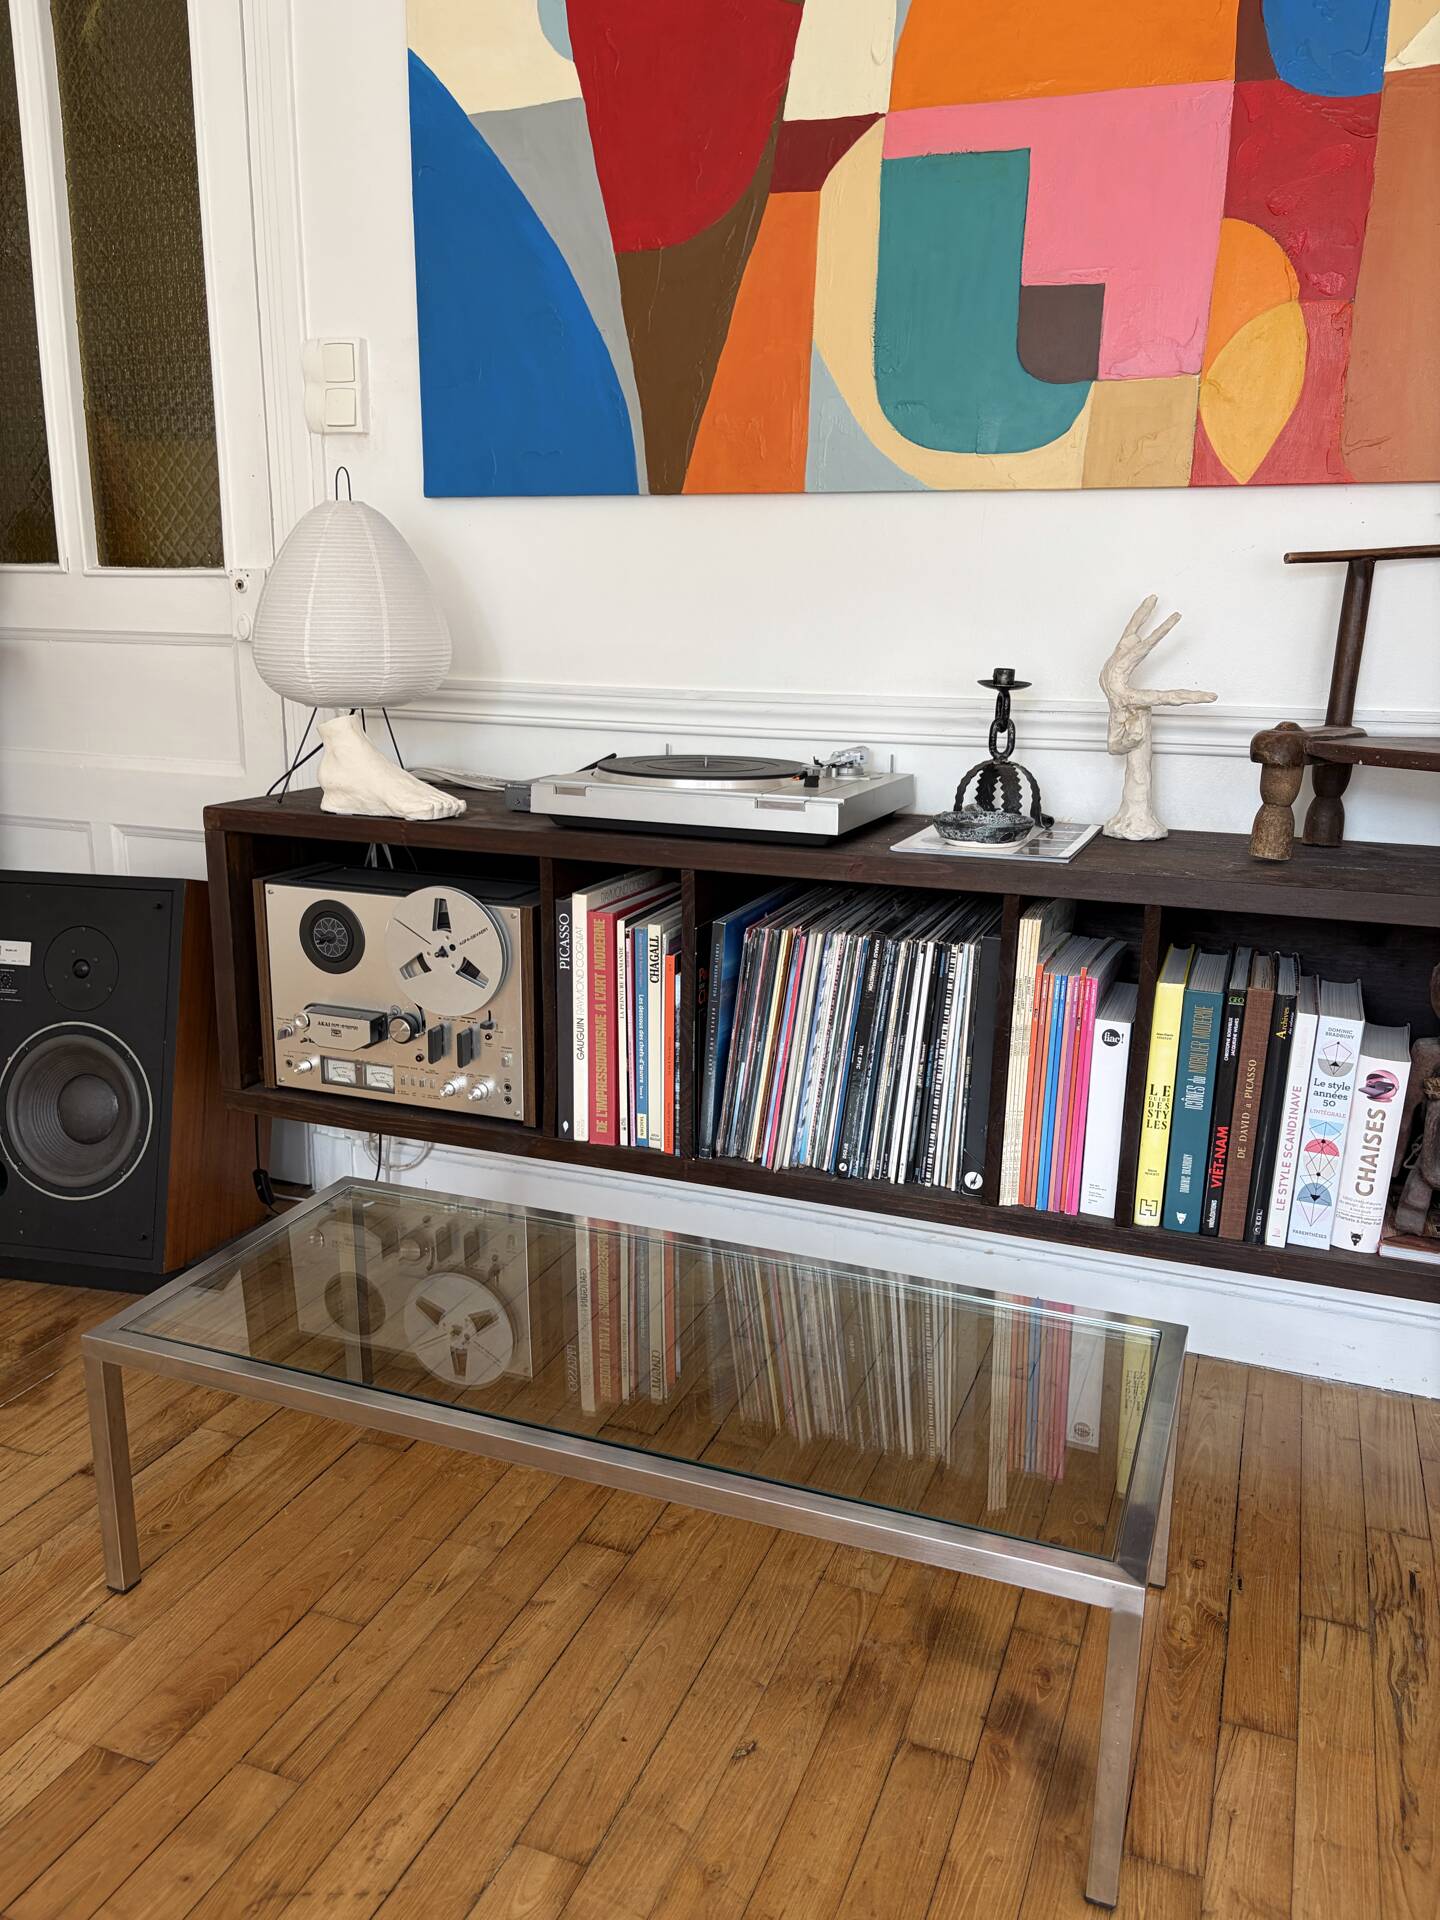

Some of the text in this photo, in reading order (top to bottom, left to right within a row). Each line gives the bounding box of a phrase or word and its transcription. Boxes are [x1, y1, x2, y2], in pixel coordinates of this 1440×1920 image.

[559, 913, 570, 970] PICASSO
[649, 935, 660, 984] CHAGALL
[867, 959, 878, 992] WASHINGTON
[576, 970, 585, 1016] RAYMOND
[593, 918, 608, 1133] DE L'IMPRESSIONNISME A L'ART MODERNE
[619, 1010, 625, 1019] LA
[1191, 1005, 1213, 1039] MODERNE
[1275, 1007, 1290, 1040] Archives
[576, 1017, 585, 1060] GAUGUIN
[1325, 1032, 1355, 1040] BRADBURY
[1328, 1027, 1353, 1035] DOMINIC
[855, 1056, 863, 1070] EPIC
[1188, 1041, 1209, 1073] MOBILIER
[1150, 1084, 1171, 1097] LE
[1245, 1059, 1258, 1099] PICASSO
[1314, 1078, 1351, 1094] Le style
[1149, 1101, 1170, 1110] DES
[1181, 1085, 1205, 1110] ICÔNES
[1313, 1090, 1348, 1101] années
[1146, 1119, 1168, 1130] LES
[1147, 1109, 1170, 1120] STY
[1239, 1112, 1250, 1142] DAVID
[1237, 1146, 1246, 1159] DE
[1275, 1085, 1302, 1211] LE STYLE SCANDINAVE
[1355, 1107, 1386, 1197] CHAISES
